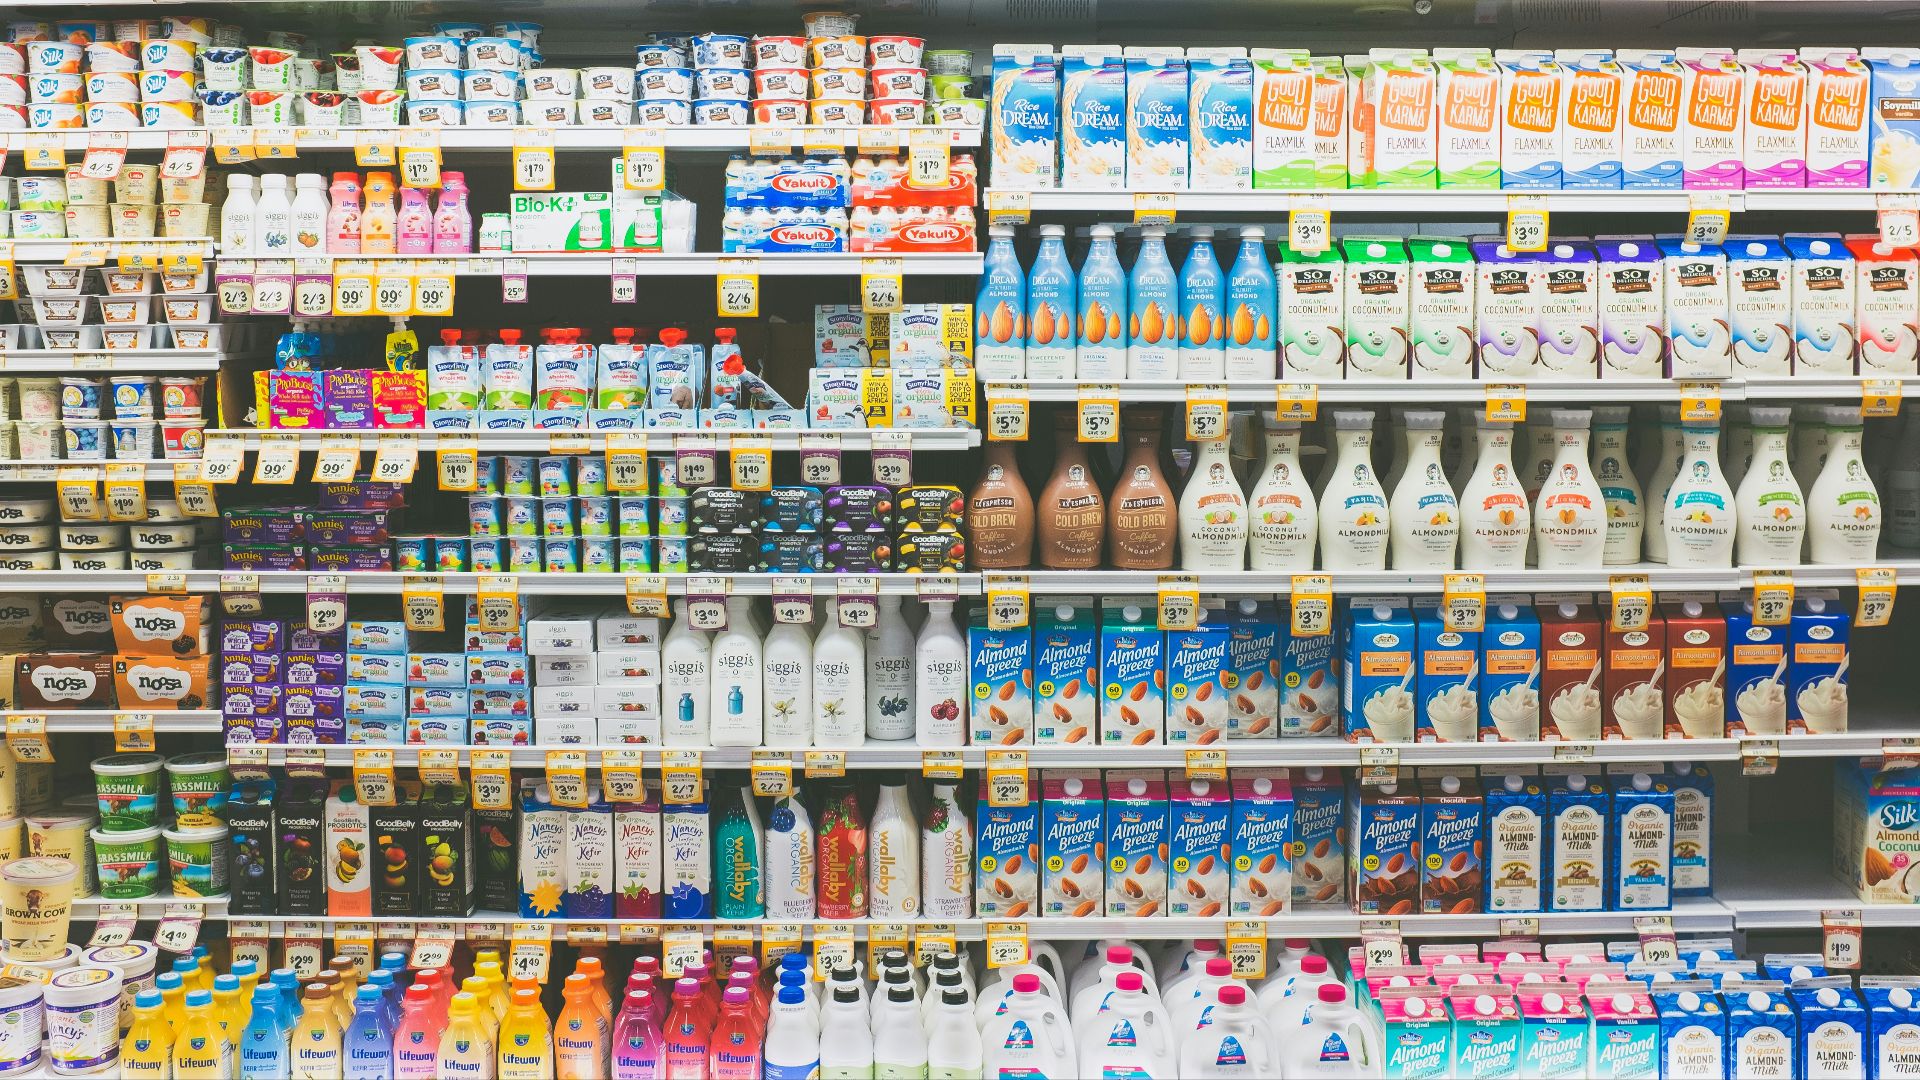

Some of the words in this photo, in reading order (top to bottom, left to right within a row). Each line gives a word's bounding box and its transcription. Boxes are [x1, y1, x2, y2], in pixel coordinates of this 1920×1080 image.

[41, 50, 63, 65] Silk
[148, 45, 167, 62] Silk
[38, 82, 58, 94] Silk
[90, 80, 104, 92] Silk
[1389, 74, 1428, 108] GOOD
[1517, 74, 1554, 108] GOOD
[1824, 74, 1861, 107] GOOD
[1014, 99, 1040, 111] Rice
[1148, 101, 1174, 112] Rice
[1212, 101, 1238, 112] Rice
[1386, 106, 1426, 128] KARMA
[1513, 105, 1554, 128] KARMA
[1820, 104, 1860, 128] KARMA
[1387, 137, 1426, 150] FLAXMILK
[1514, 137, 1552, 150] FLAXMILK
[1820, 136, 1859, 149] FLAXMILK
[782, 177, 828, 189] Yakult
[781, 231, 827, 243] Yakult
[908, 229, 957, 240] Yakult
[1304, 271, 1322, 280] SO
[1501, 271, 1520, 280] SO
[1816, 268, 1834, 276] SO
[1674, 298, 1724, 307] COCONUTMILK
[1800, 302, 1850, 311] COCONUTMILK
[1288, 306, 1339, 314] COCONUTMILK
[1352, 306, 1402, 314] COCONUTMILK
[903, 316, 938, 325] Stonyfield
[903, 328, 938, 338] organic
[436, 362, 469, 371] Stonyfield
[546, 362, 578, 370] Stonyfield
[823, 392, 858, 403] organic
[708, 490, 744, 500] GoodBelly
[840, 489, 876, 498] GoodBelly
[311, 520, 345, 530] Annie's
[970, 515, 989, 527] COLD
[991, 514, 1016, 526] BREW
[1118, 514, 1140, 528] COLD
[1142, 514, 1166, 526] BREW
[1671, 526, 1728, 534] ALMONDMILK
[67, 534, 99, 544] noosa
[140, 533, 173, 544] noosa
[912, 536, 949, 544] GoodBelly
[974, 640, 1028, 667] Almond
[1172, 642, 1224, 668] Almond
[986, 657, 1022, 678] Breeze
[1118, 658, 1154, 679] Breeze
[1183, 659, 1220, 679] Breeze
[44, 676, 88, 690] noosa
[139, 677, 182, 690] noosa
[1882, 803, 1917, 826] Silk
[230, 819, 268, 828] GoodBelly
[376, 820, 415, 828] GoodBelly
[1112, 815, 1164, 841] Almond
[1364, 812, 1416, 840] Almond
[1247, 831, 1283, 851] Breeze
[1876, 830, 1919, 840] Almond
[1879, 841, 1920, 851] Coconu
[726, 838, 734, 890] ORGANIC
[729, 836, 751, 902] wallaby
[795, 830, 814, 896] wallaby
[6, 907, 41, 919] BROWN
[44, 907, 66, 918] COW
[558, 1036, 593, 1049] Lifeway
[668, 1042, 706, 1054] Lifeway
[300, 1048, 337, 1060] Lifeway
[1390, 1036, 1445, 1067] Almond
[124, 1059, 161, 1072] Lifeway
[1402, 1052, 1440, 1076] Breeze
[1538, 1051, 1576, 1072] Breeze
